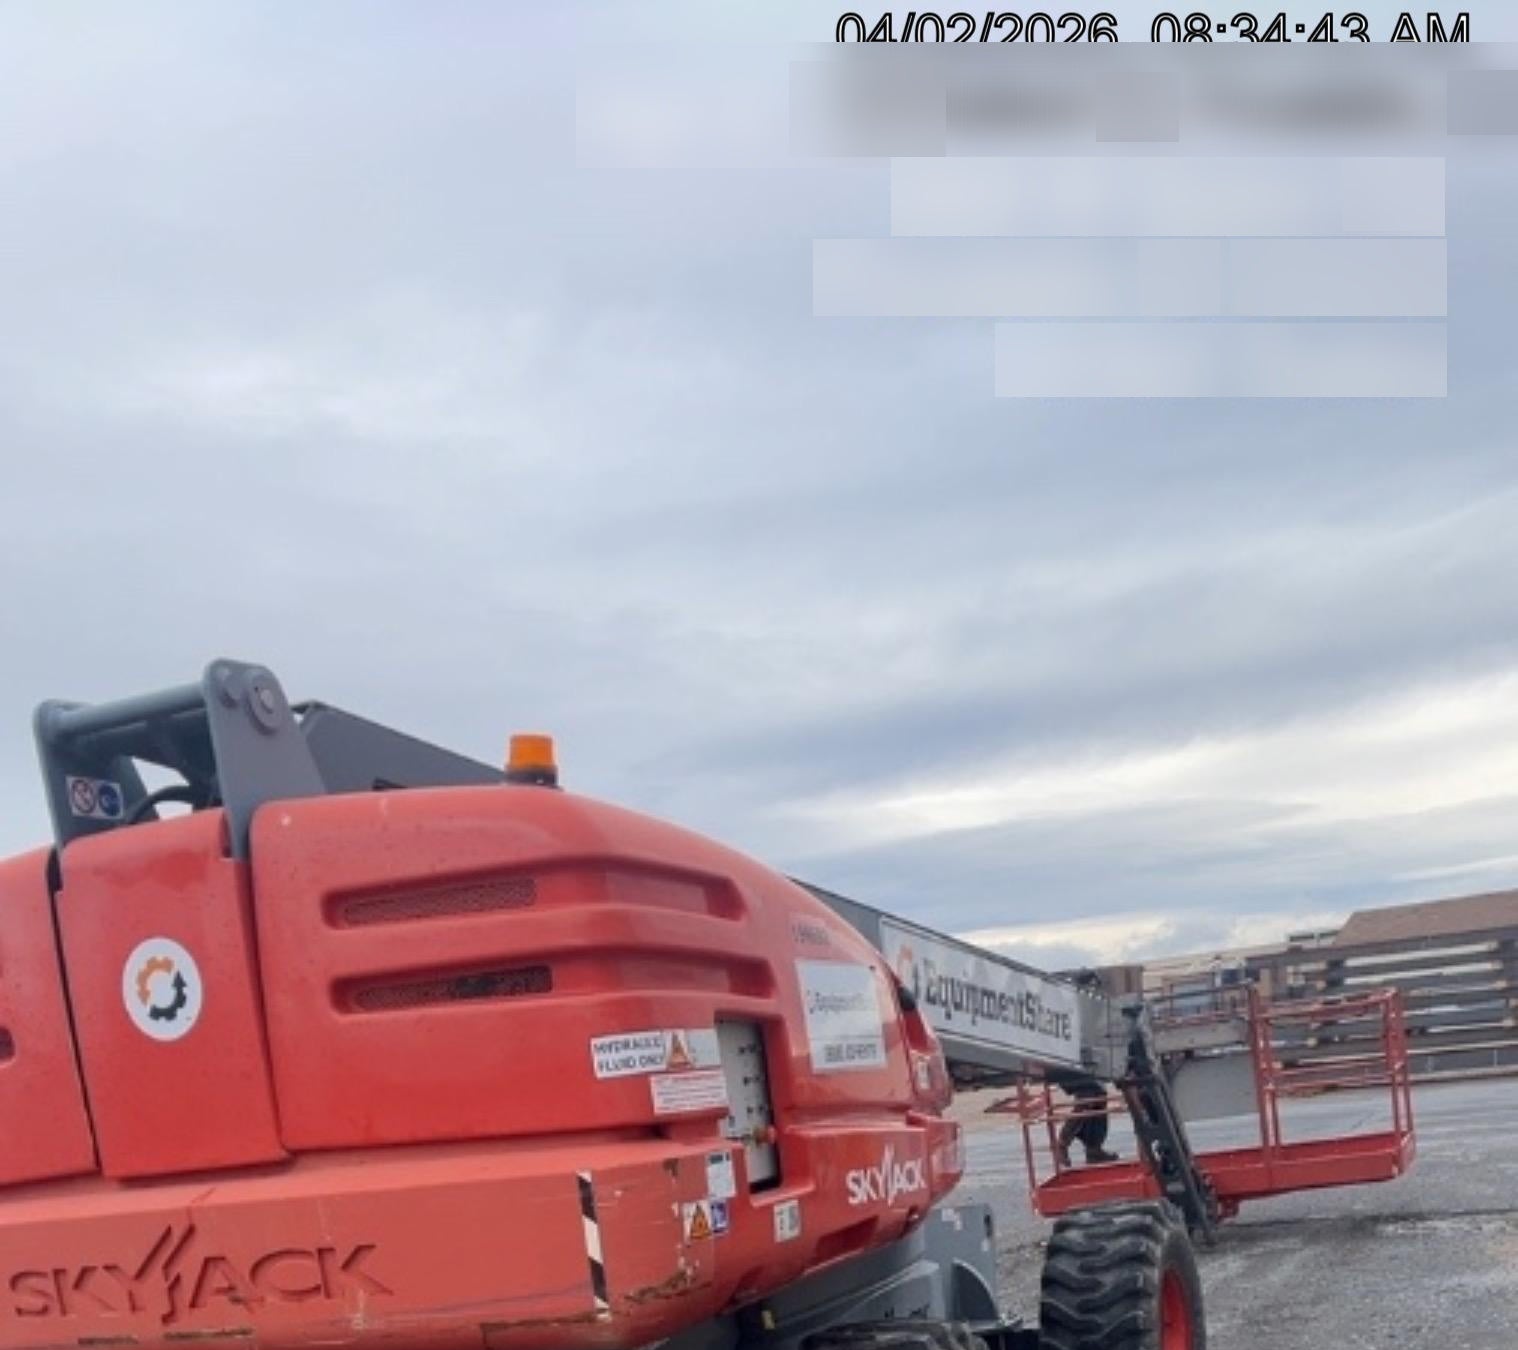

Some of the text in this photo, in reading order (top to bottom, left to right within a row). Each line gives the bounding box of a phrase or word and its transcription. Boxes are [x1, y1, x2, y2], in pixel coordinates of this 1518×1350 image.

[597, 1056, 636, 1072] FLUID
[846, 1143, 927, 1207] SKYJACK
[9, 1224, 393, 1326] SKYJACK
